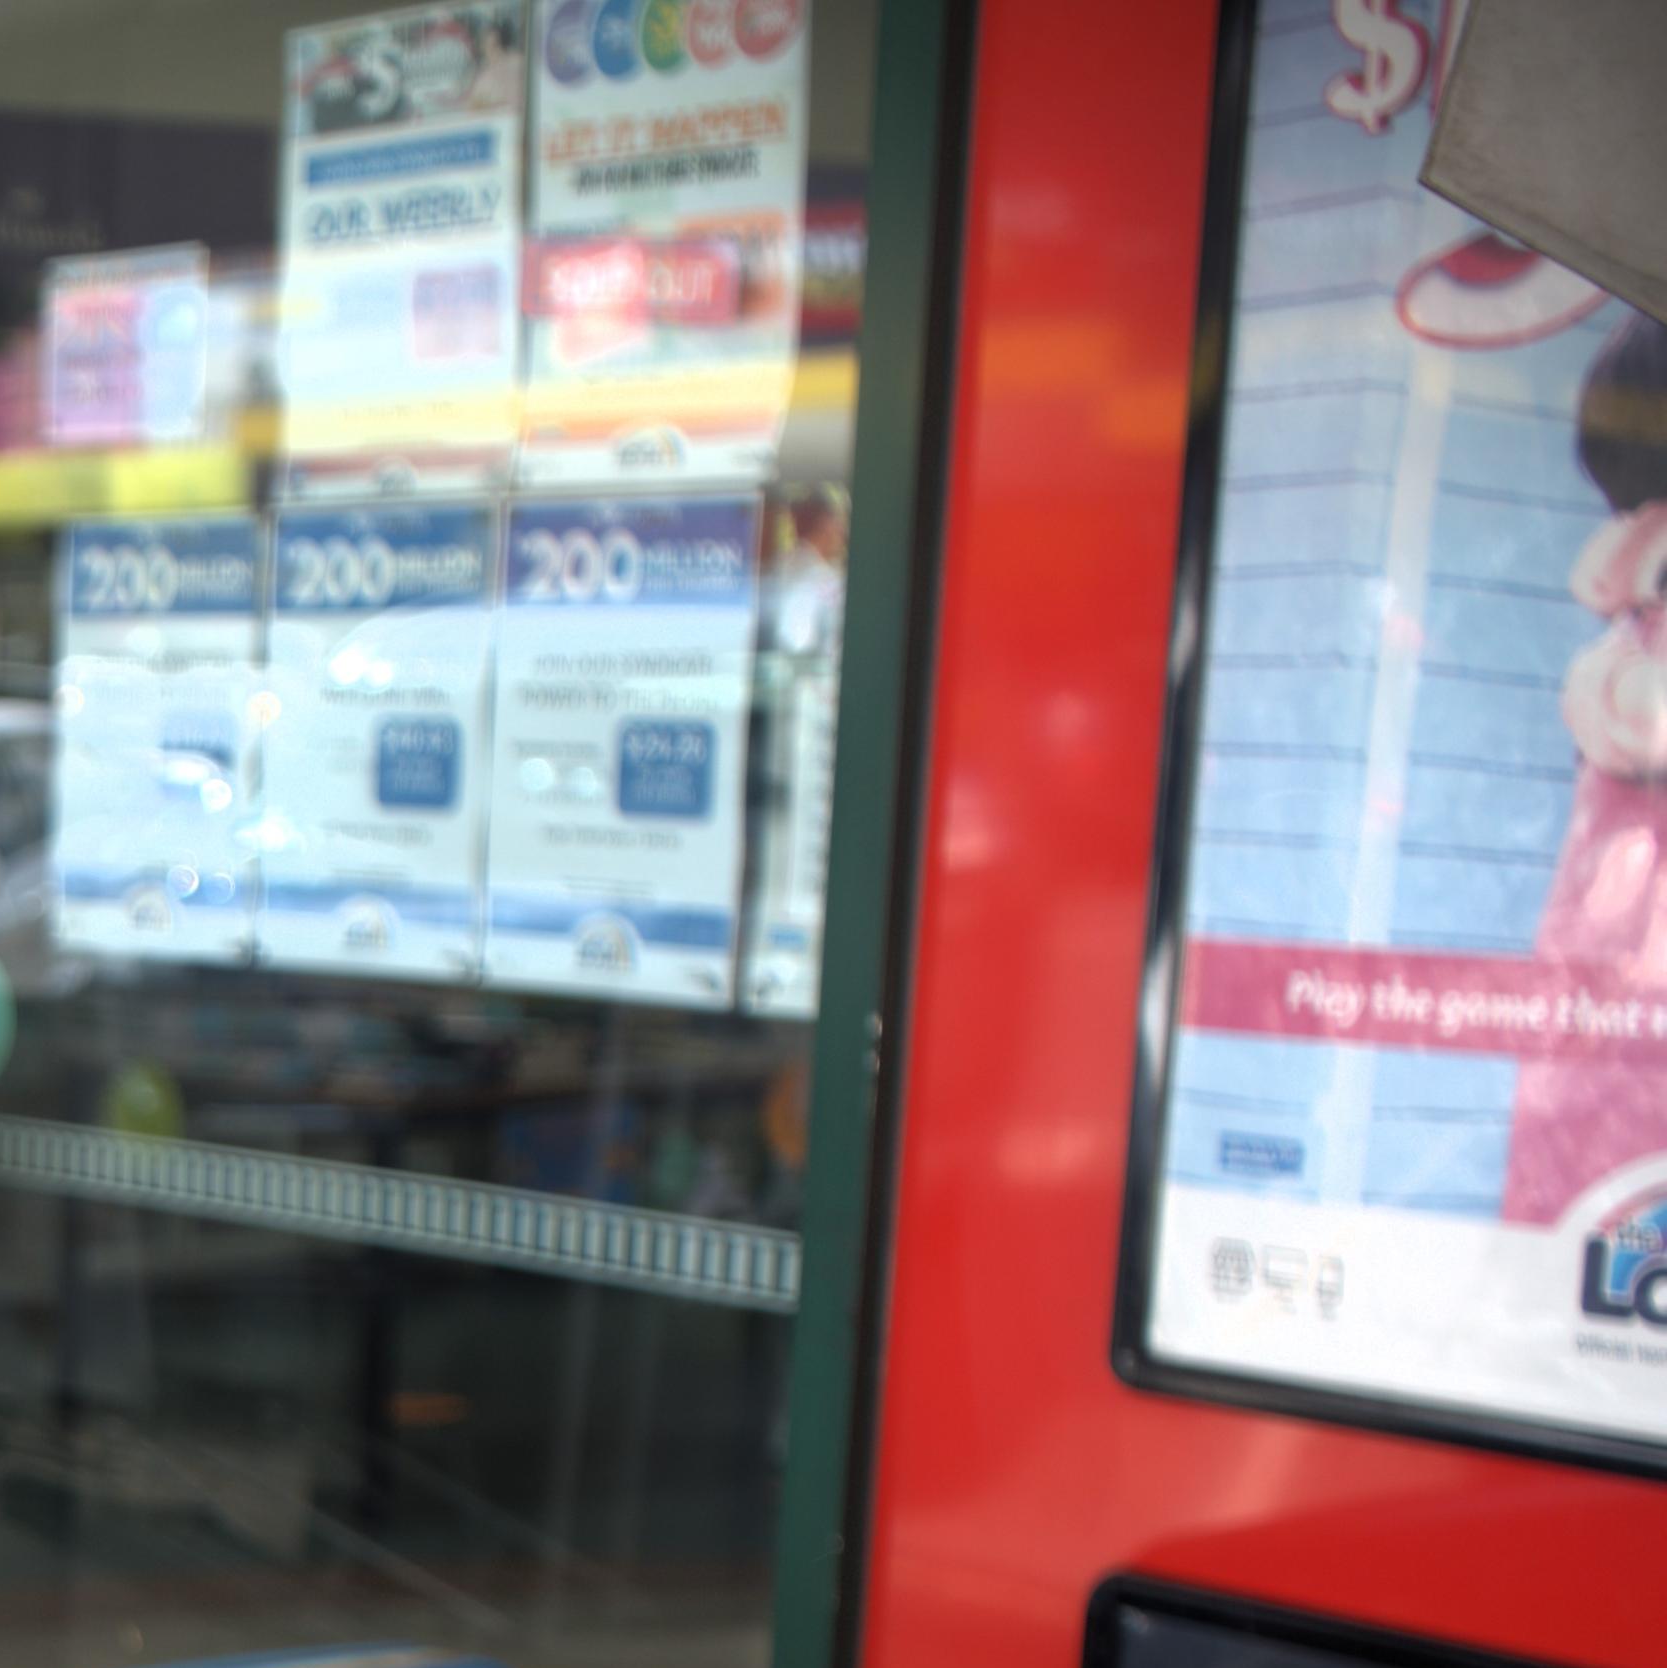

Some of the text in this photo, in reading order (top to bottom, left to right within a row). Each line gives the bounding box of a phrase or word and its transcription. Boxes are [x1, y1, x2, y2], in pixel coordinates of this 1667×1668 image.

[80, 546, 175, 610] 200
[290, 538, 394, 606] 200
[517, 527, 642, 602] 200
[1287, 968, 1644, 1038] Play the game that
[1580, 1230, 1667, 1326] Lo
